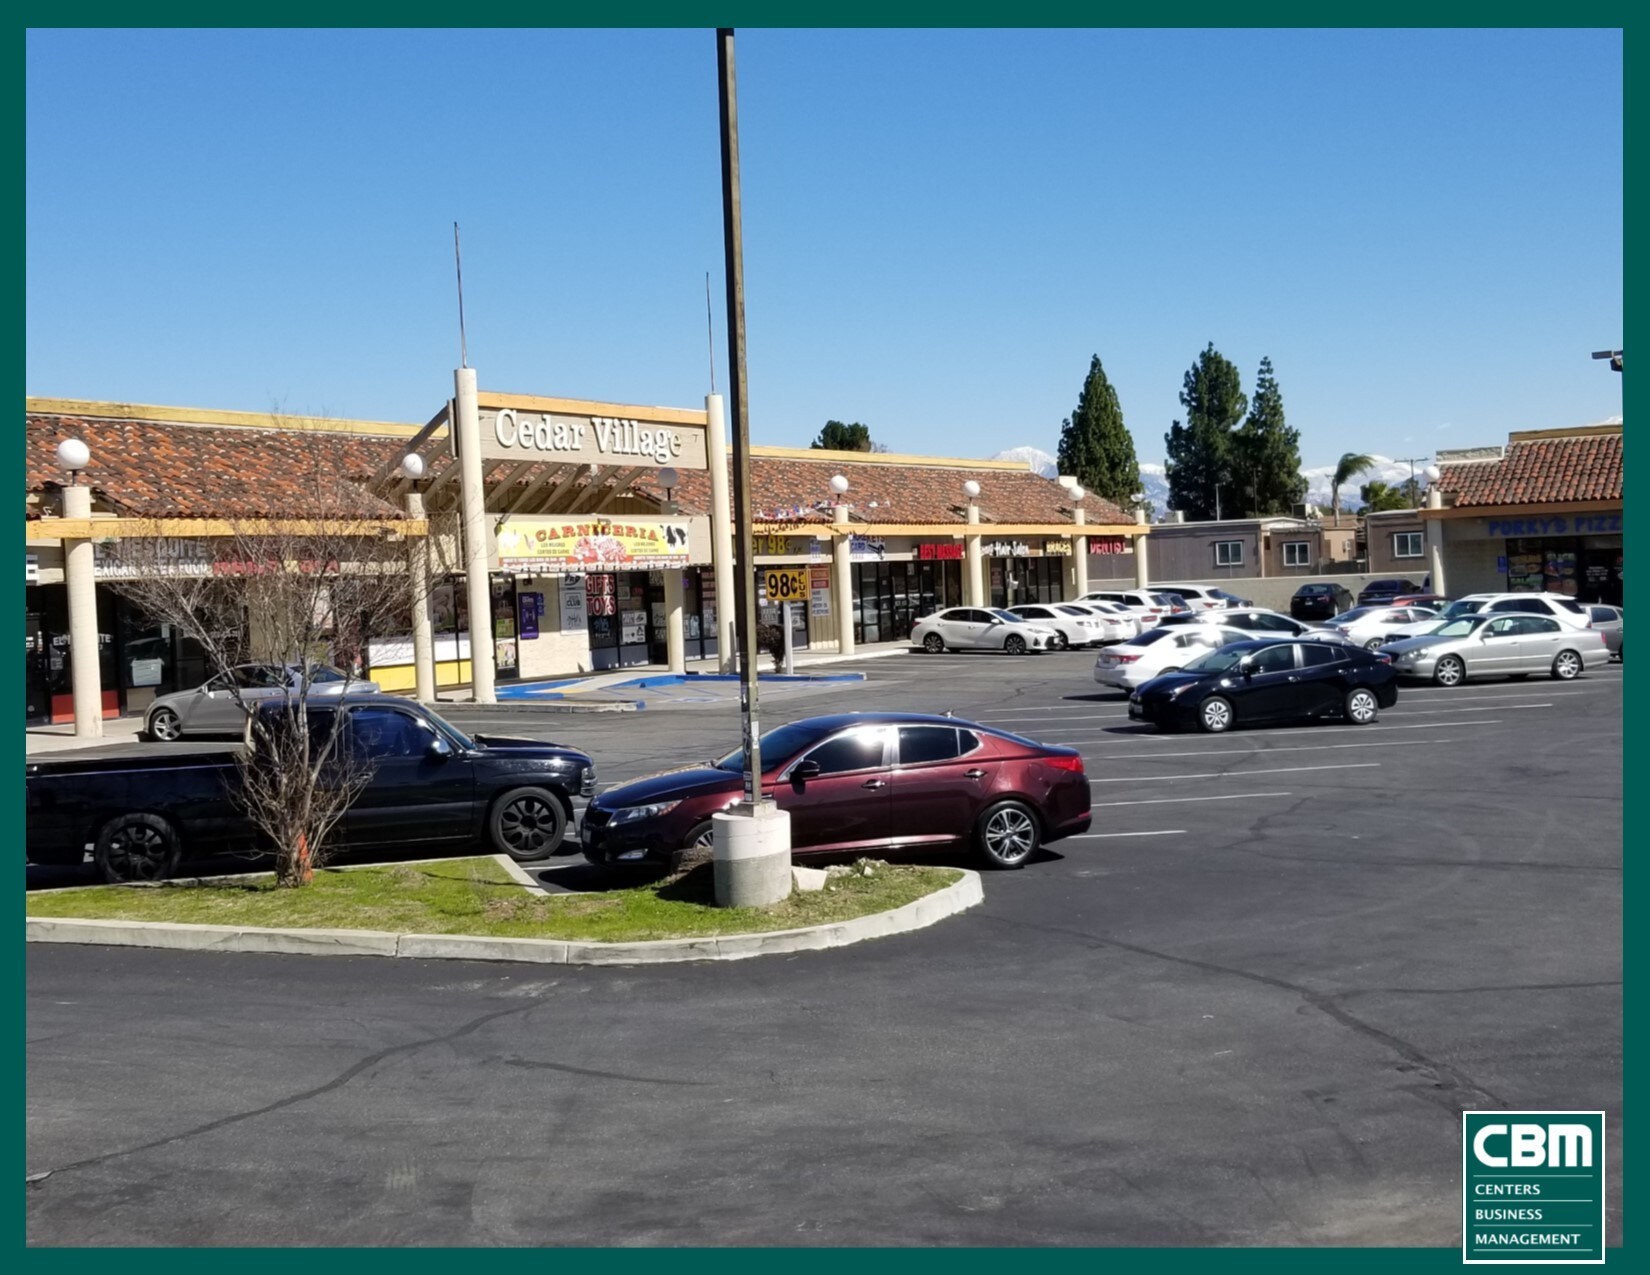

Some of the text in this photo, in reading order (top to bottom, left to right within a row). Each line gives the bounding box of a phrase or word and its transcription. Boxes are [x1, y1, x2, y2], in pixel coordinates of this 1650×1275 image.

[495, 409, 682, 463] Cedar Village
[535, 523, 659, 542] CARNICERIA
[1489, 517, 1568, 536] PORKY'S
[93, 559, 137, 577] EXICAN
[585, 574, 615, 594] GIFTS
[586, 595, 616, 616] TOYS
